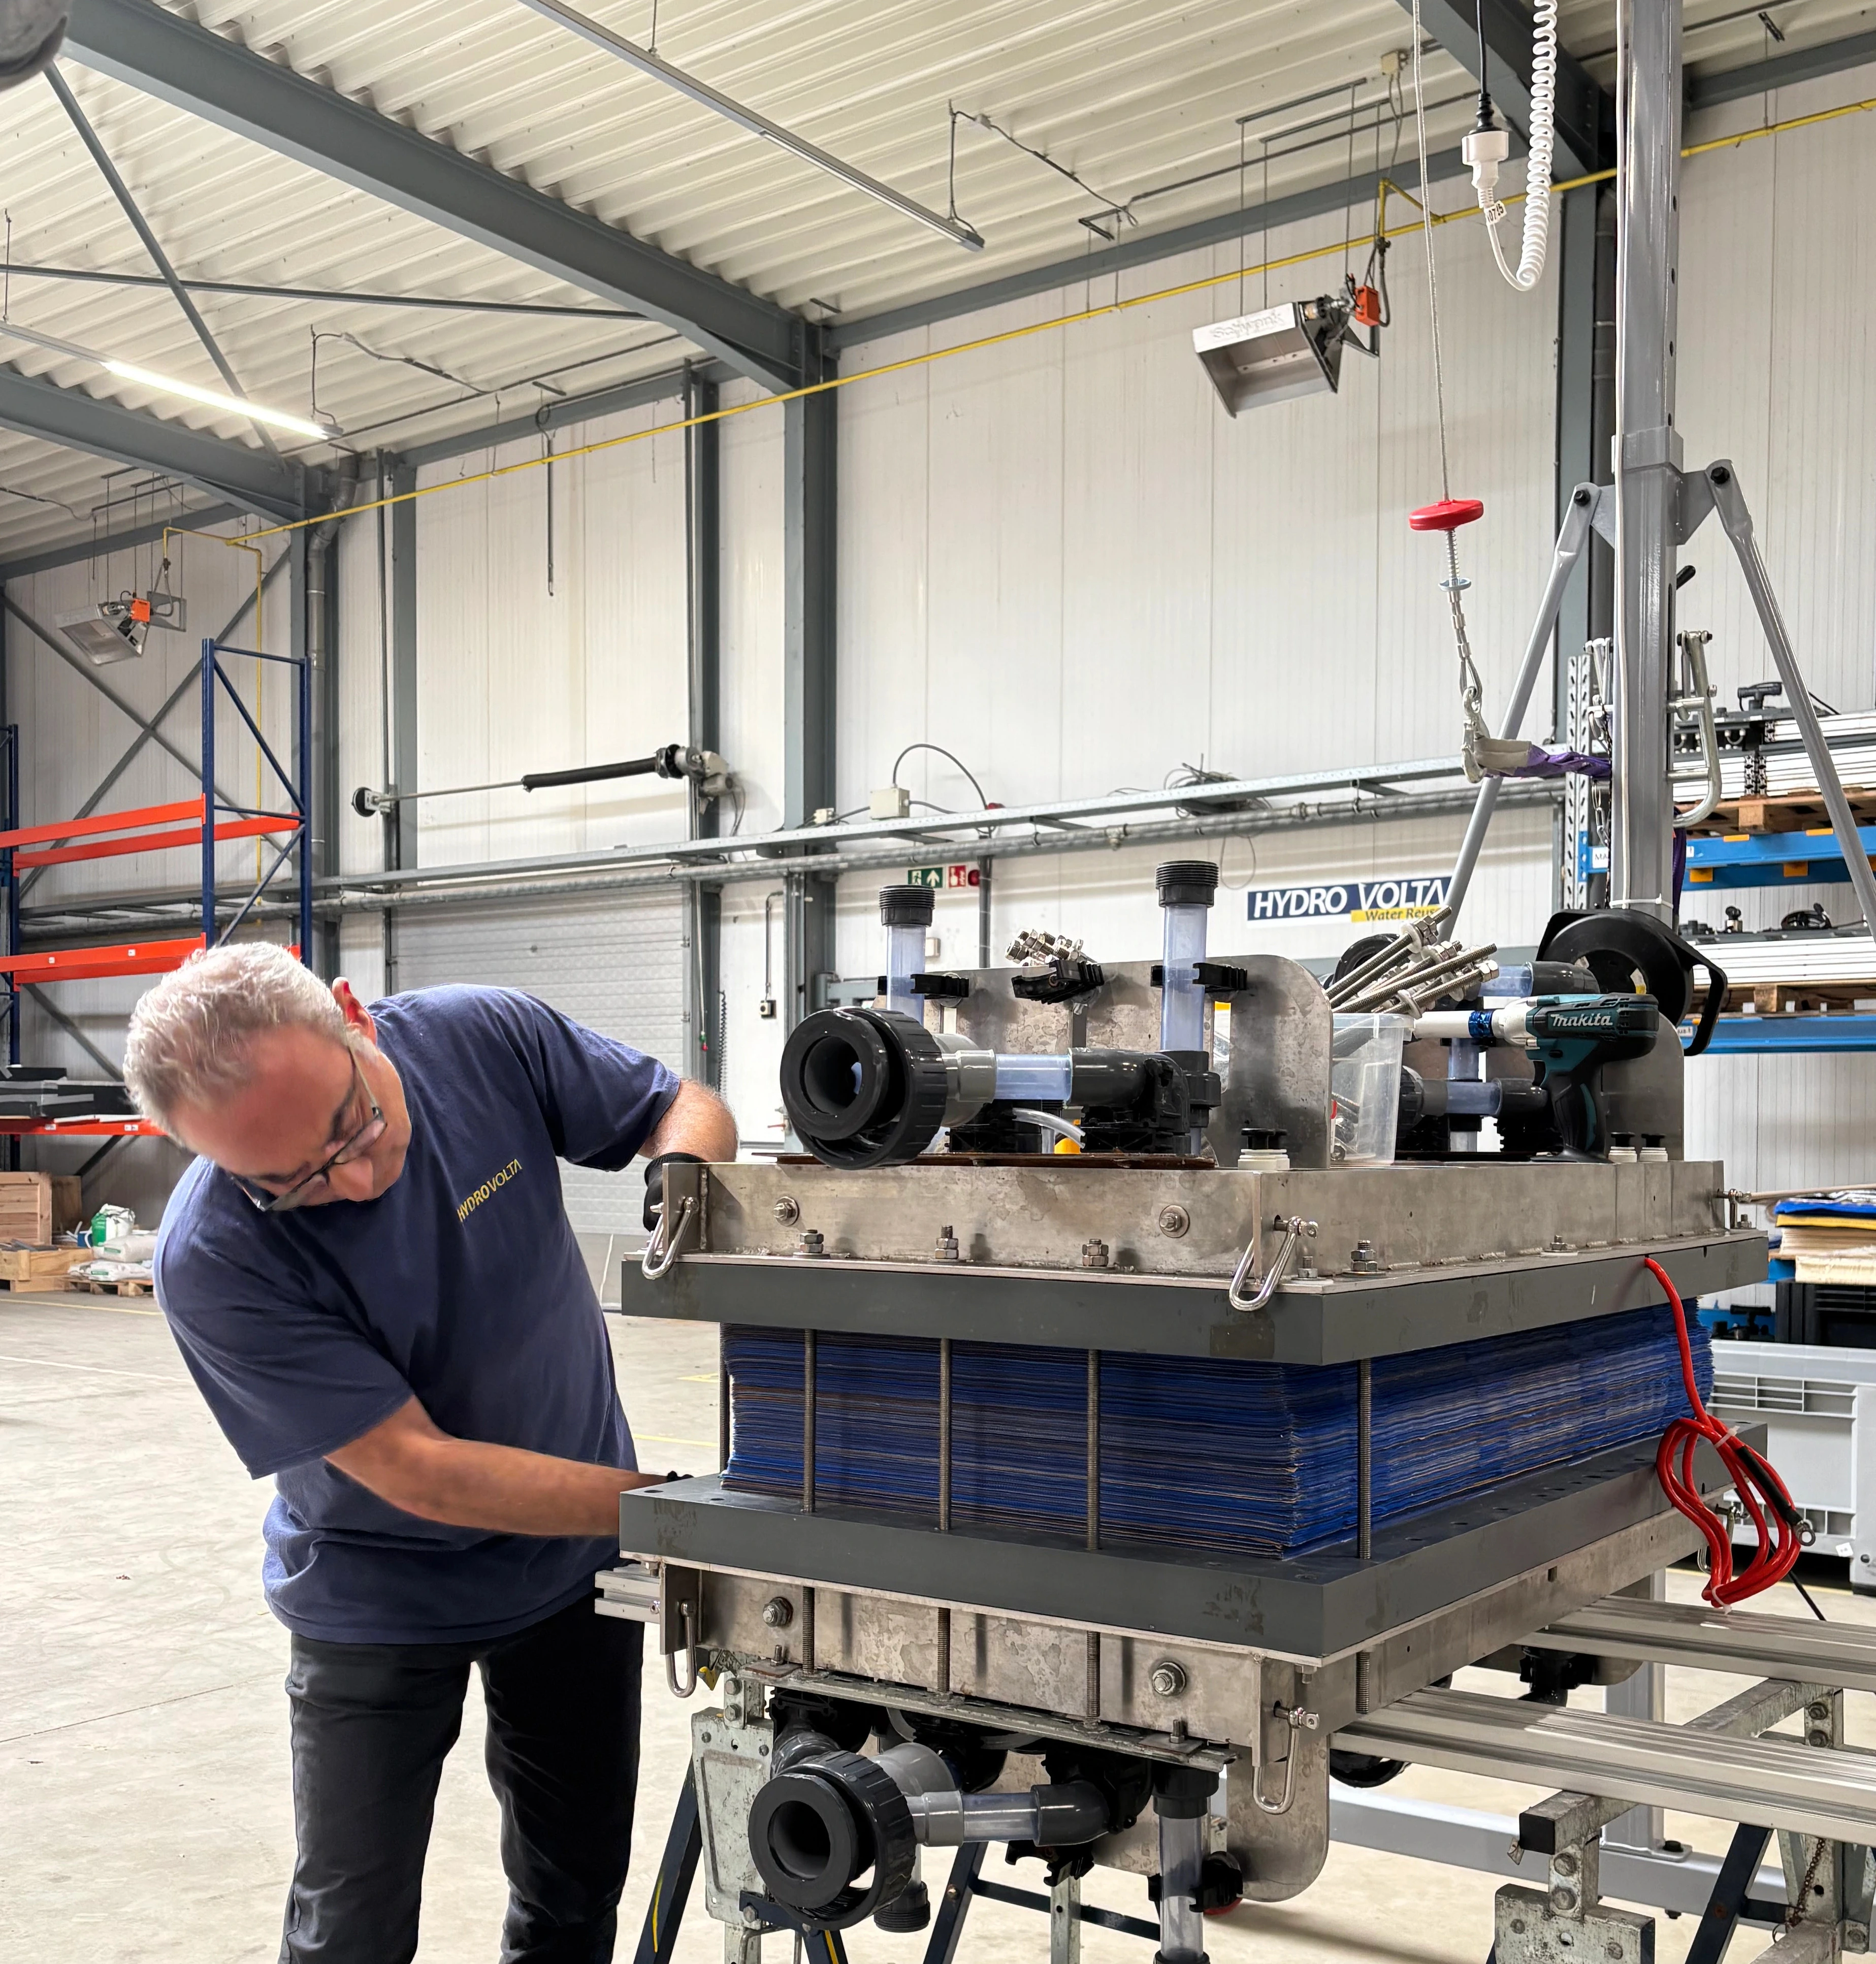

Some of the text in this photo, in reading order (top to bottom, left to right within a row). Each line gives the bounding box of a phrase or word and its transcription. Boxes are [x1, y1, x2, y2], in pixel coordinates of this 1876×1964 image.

[1253, 879, 1446, 918] HYDRO VOLTA
[1365, 910, 1403, 921] Water
